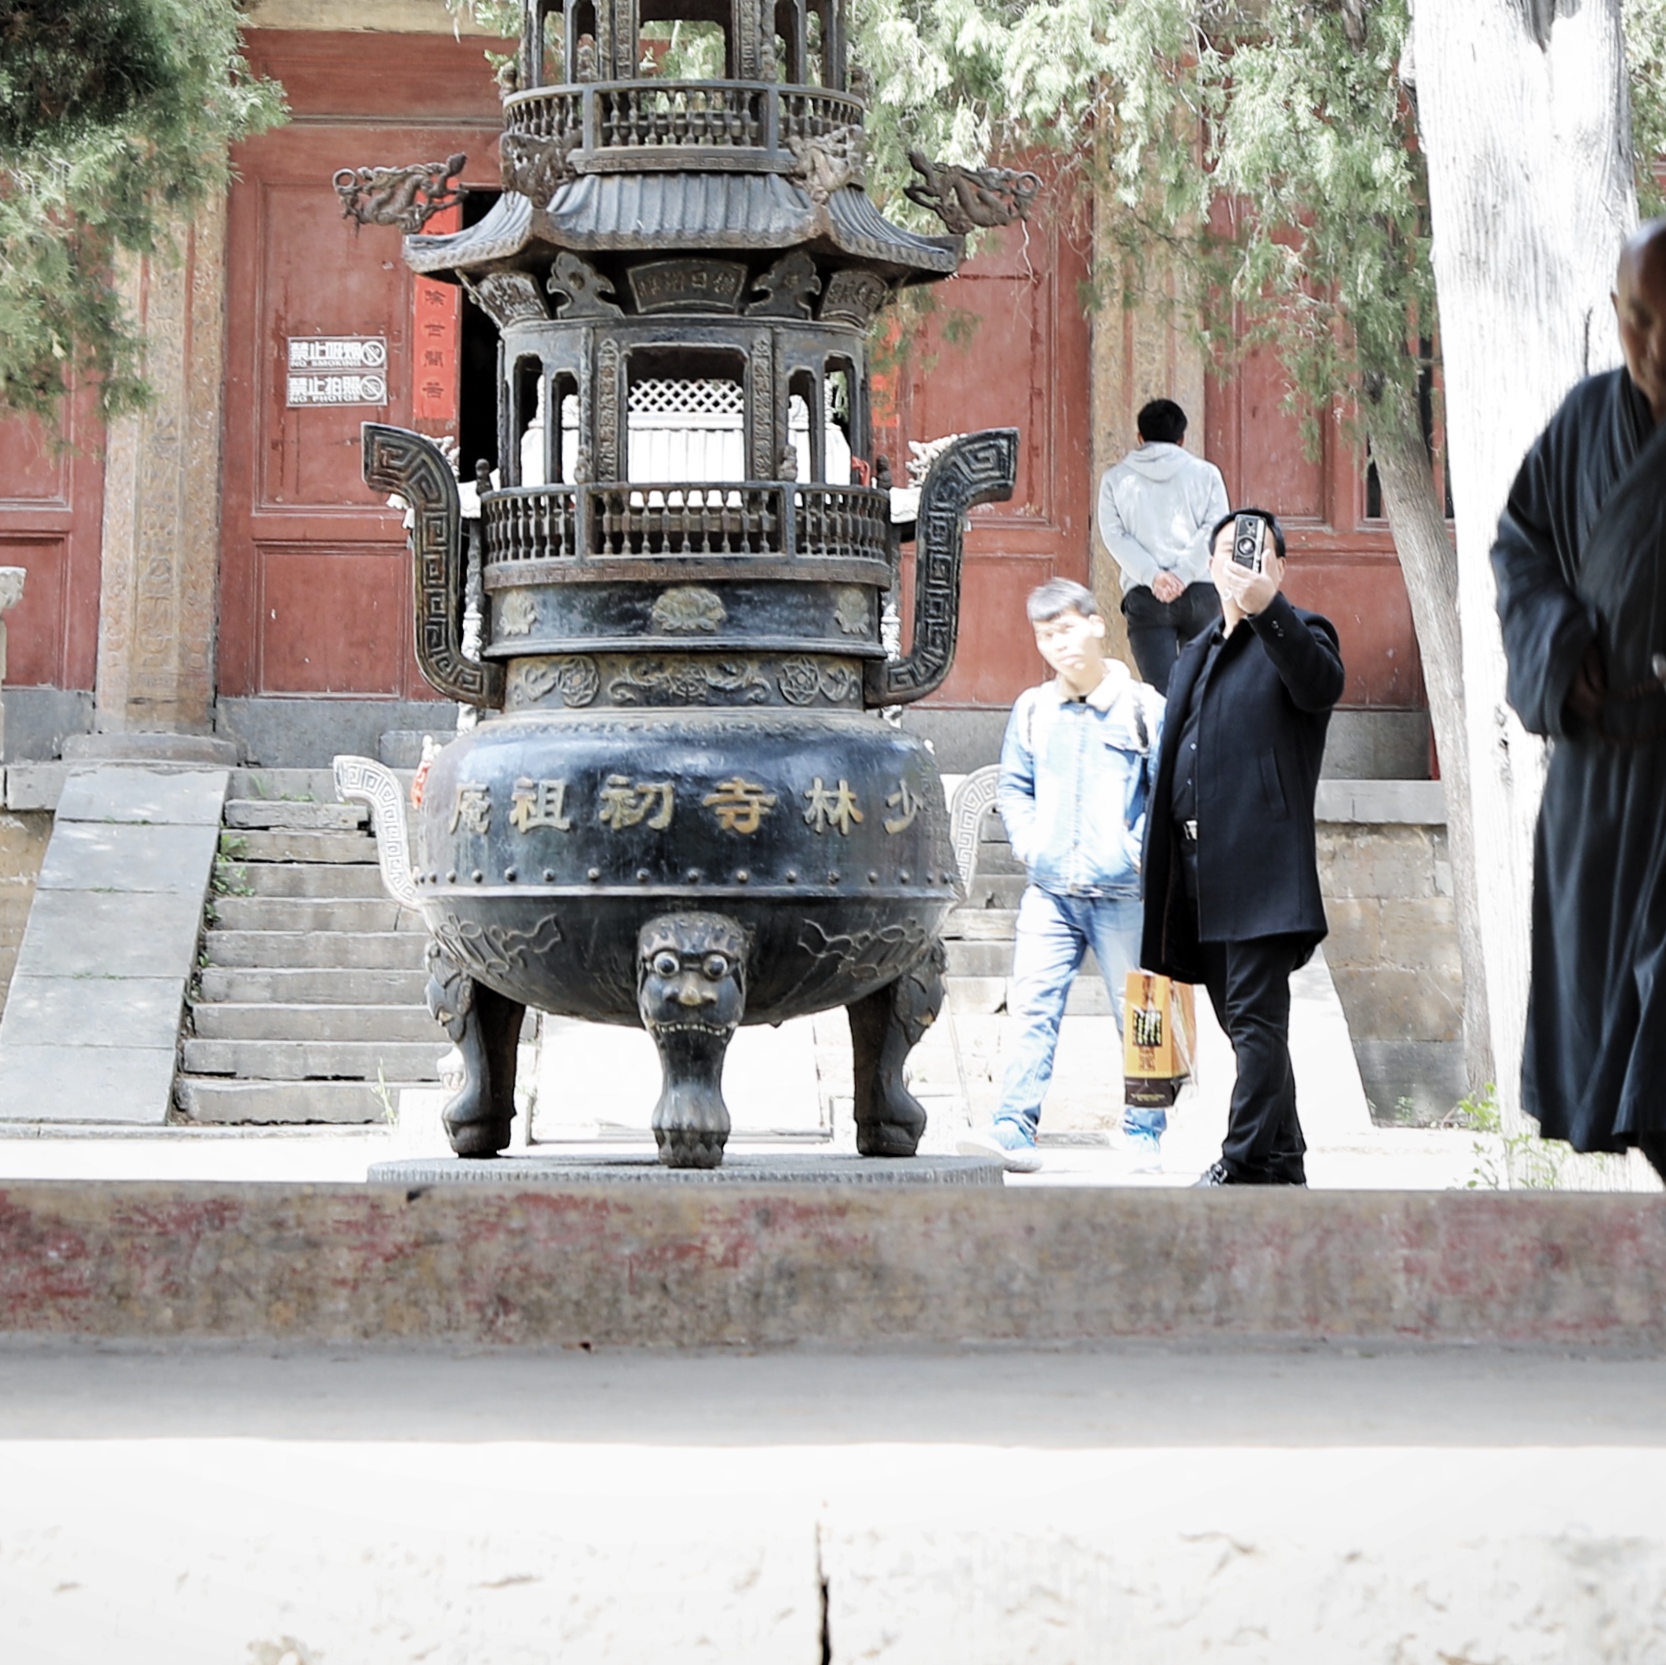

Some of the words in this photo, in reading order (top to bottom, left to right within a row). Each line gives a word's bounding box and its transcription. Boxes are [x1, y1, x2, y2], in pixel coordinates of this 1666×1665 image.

[289, 376, 361, 396] 禁止拍照
[289, 395, 307, 403] NO
[447, 773, 925, 836] 少林寺初祖庵
